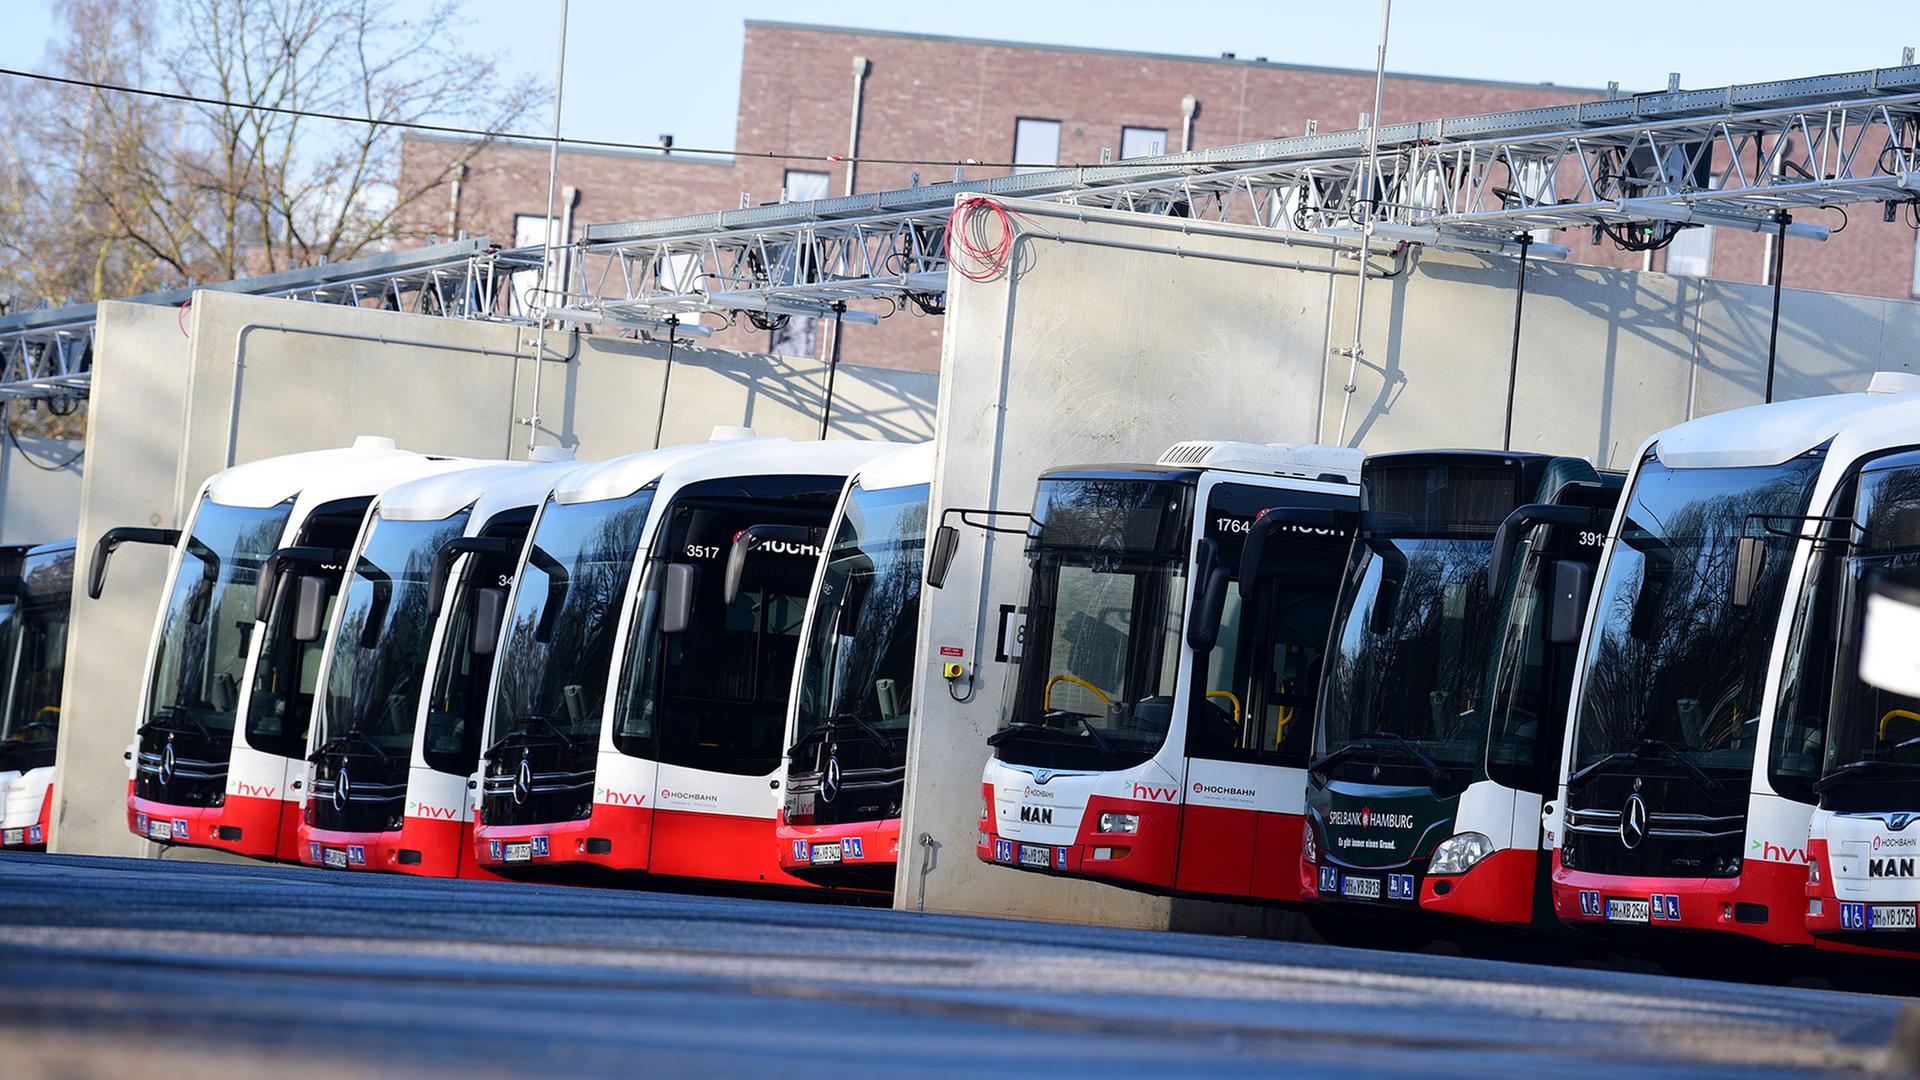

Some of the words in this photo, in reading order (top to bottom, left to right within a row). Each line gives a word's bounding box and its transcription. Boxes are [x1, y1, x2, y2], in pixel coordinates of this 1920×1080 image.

[1216, 517, 1250, 534] 1764
[686, 544, 720, 559] 3517
[236, 781, 276, 798] hvv
[605, 788, 646, 806] hvv
[670, 791, 718, 802] HOCHBAHN
[1132, 782, 1178, 802] hvv
[1203, 785, 1256, 797] HOCHBAHN
[417, 802, 457, 819] hvv
[1020, 806, 1053, 824] MAN
[1329, 811, 1362, 826] SPIELBANK
[1369, 814, 1414, 829] HAMBURG
[1881, 837, 1917, 847] HOCHBAHN
[1868, 857, 1915, 878] MAN
